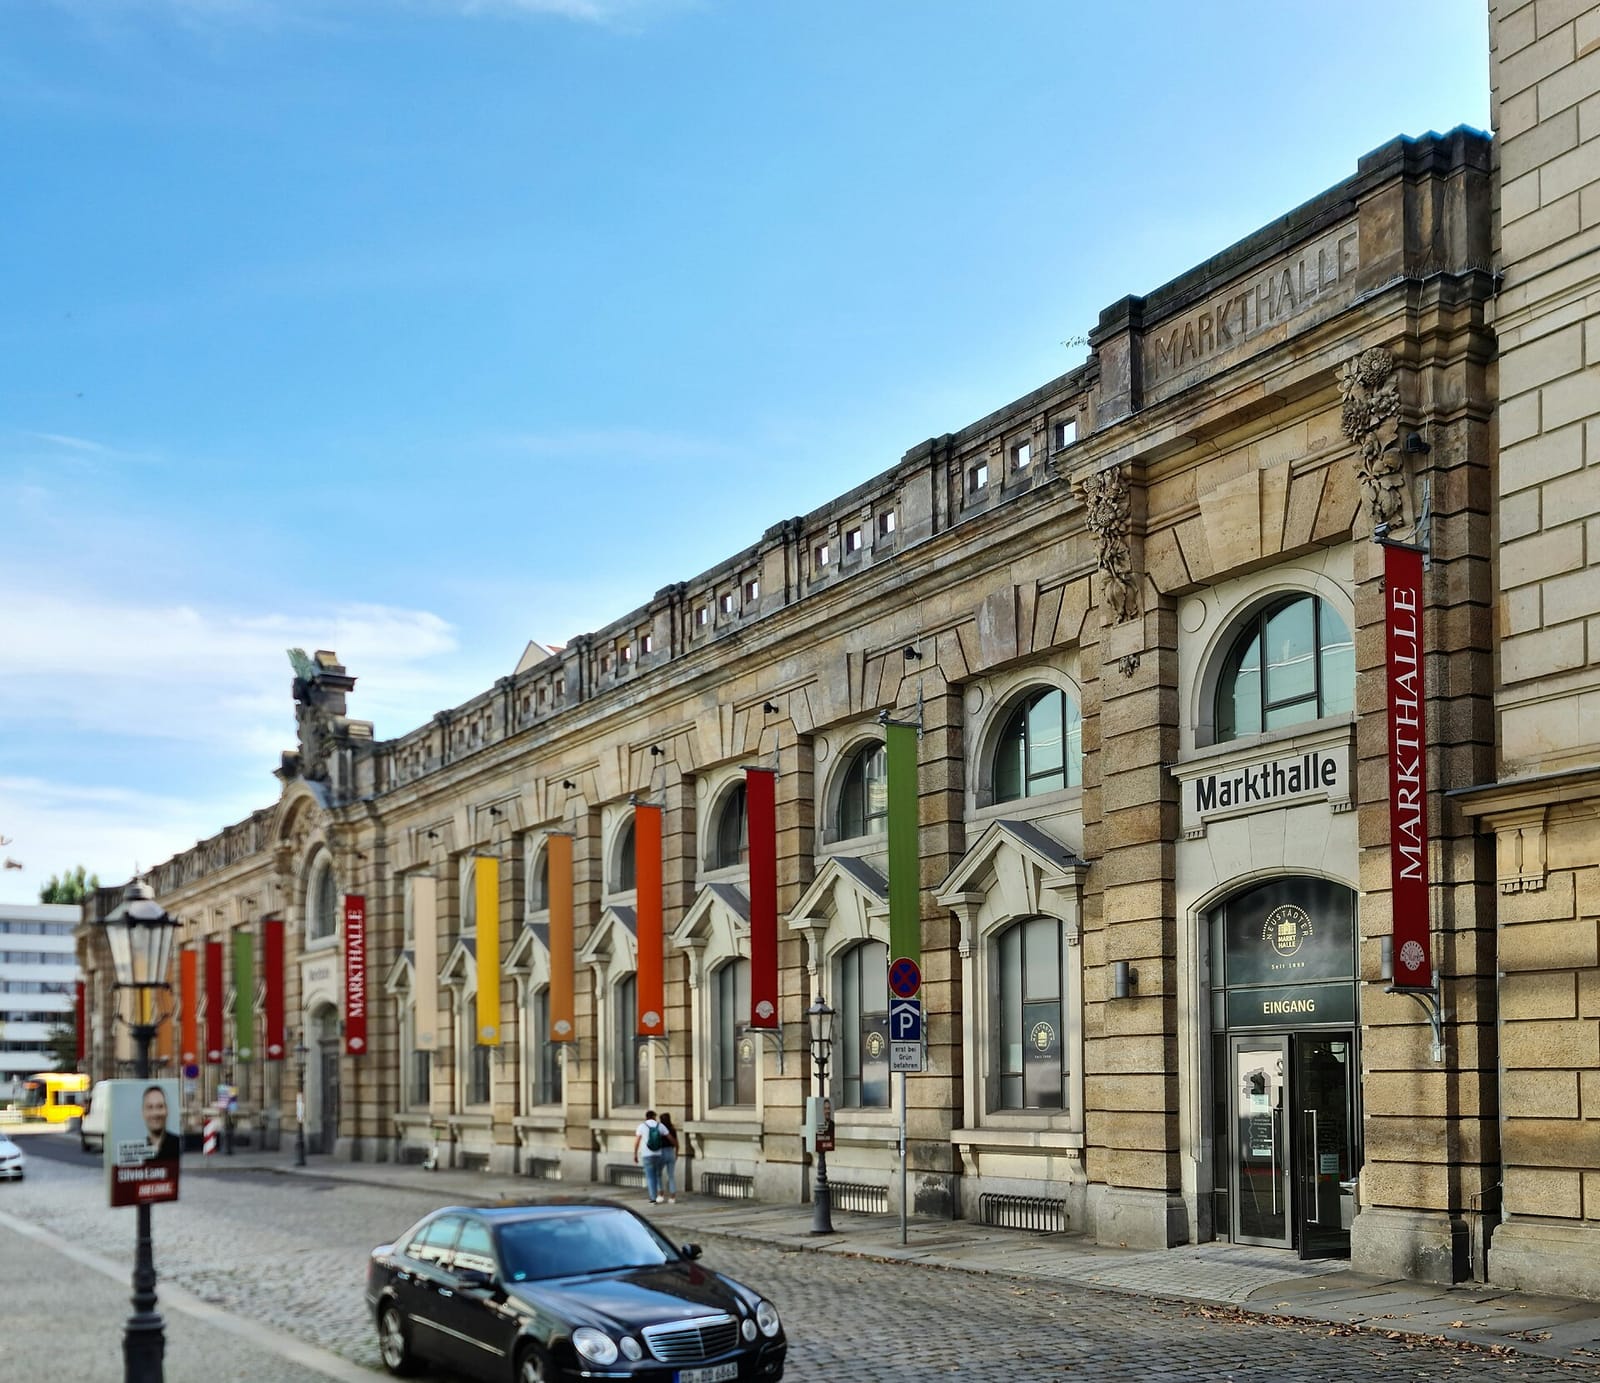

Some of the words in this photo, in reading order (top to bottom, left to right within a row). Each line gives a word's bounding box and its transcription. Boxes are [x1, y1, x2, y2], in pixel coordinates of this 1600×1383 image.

[1154, 231, 1358, 379] MARKTHALLE
[1393, 586, 1422, 882] MARKTHALLE
[1196, 752, 1337, 812] Markthalle
[1278, 934, 1297, 942] MARKT
[1278, 941, 1297, 949] HALLE
[348, 910, 364, 1018] MARKTHALLE
[900, 1012, 914, 1038] P
[1263, 999, 1315, 1014] EINGANG
